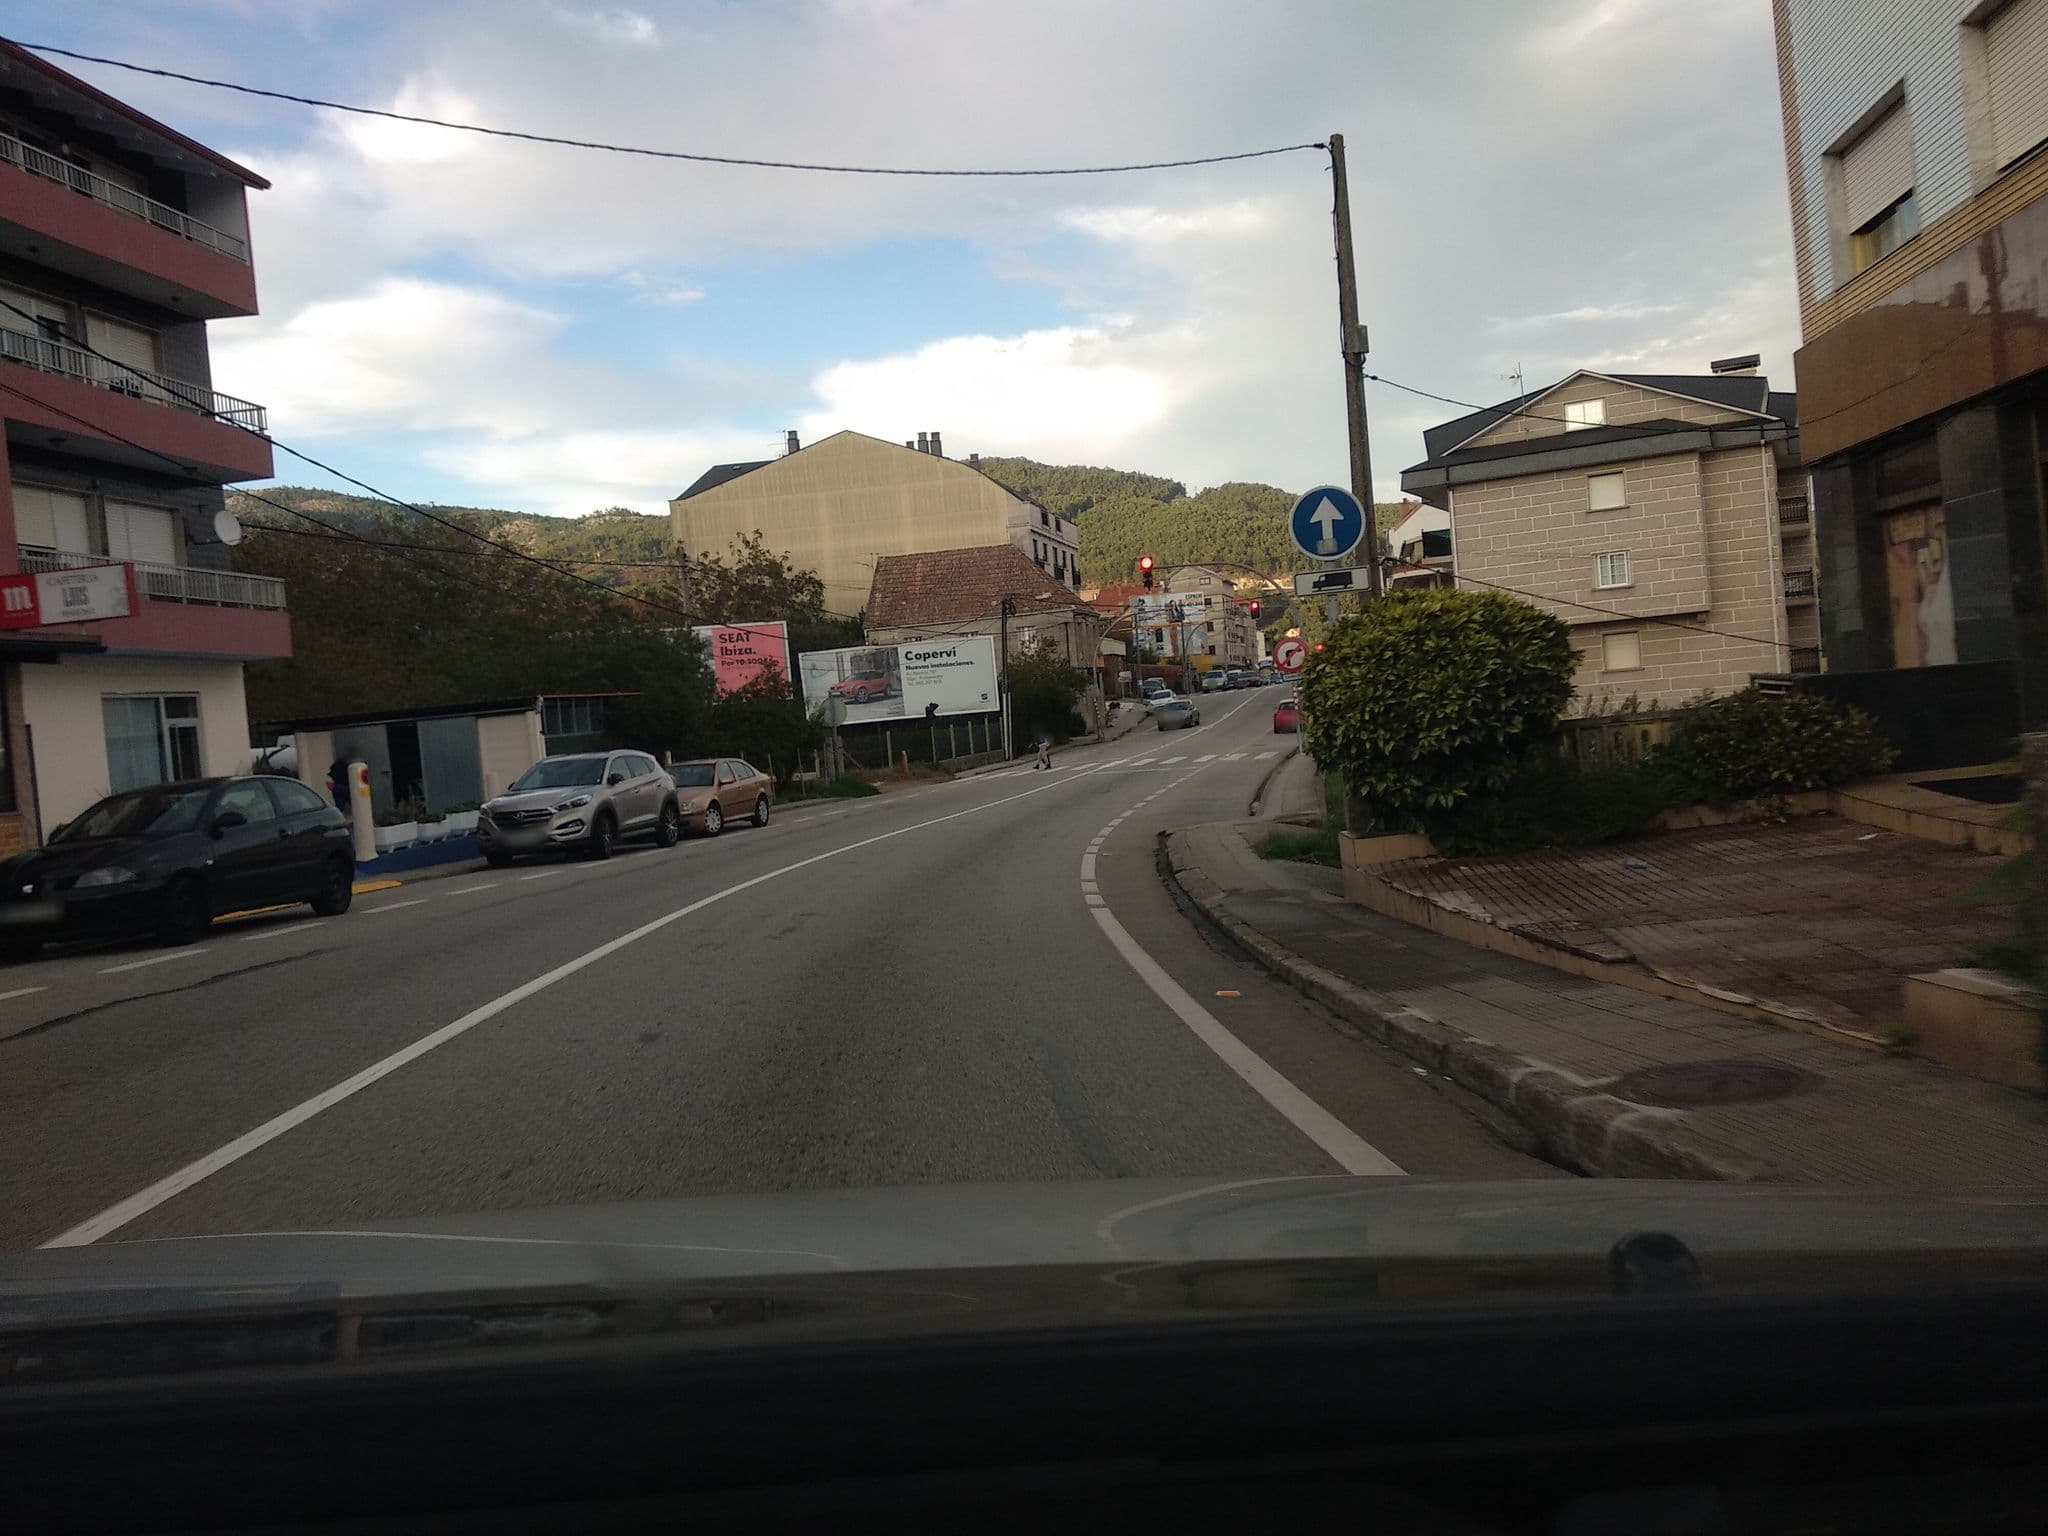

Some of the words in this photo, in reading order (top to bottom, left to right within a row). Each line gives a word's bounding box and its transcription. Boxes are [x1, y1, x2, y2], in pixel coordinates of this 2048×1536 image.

[719, 632, 752, 644] SEAT
[720, 645, 757, 657] Ibiza.
[904, 646, 957, 662] Copervi
